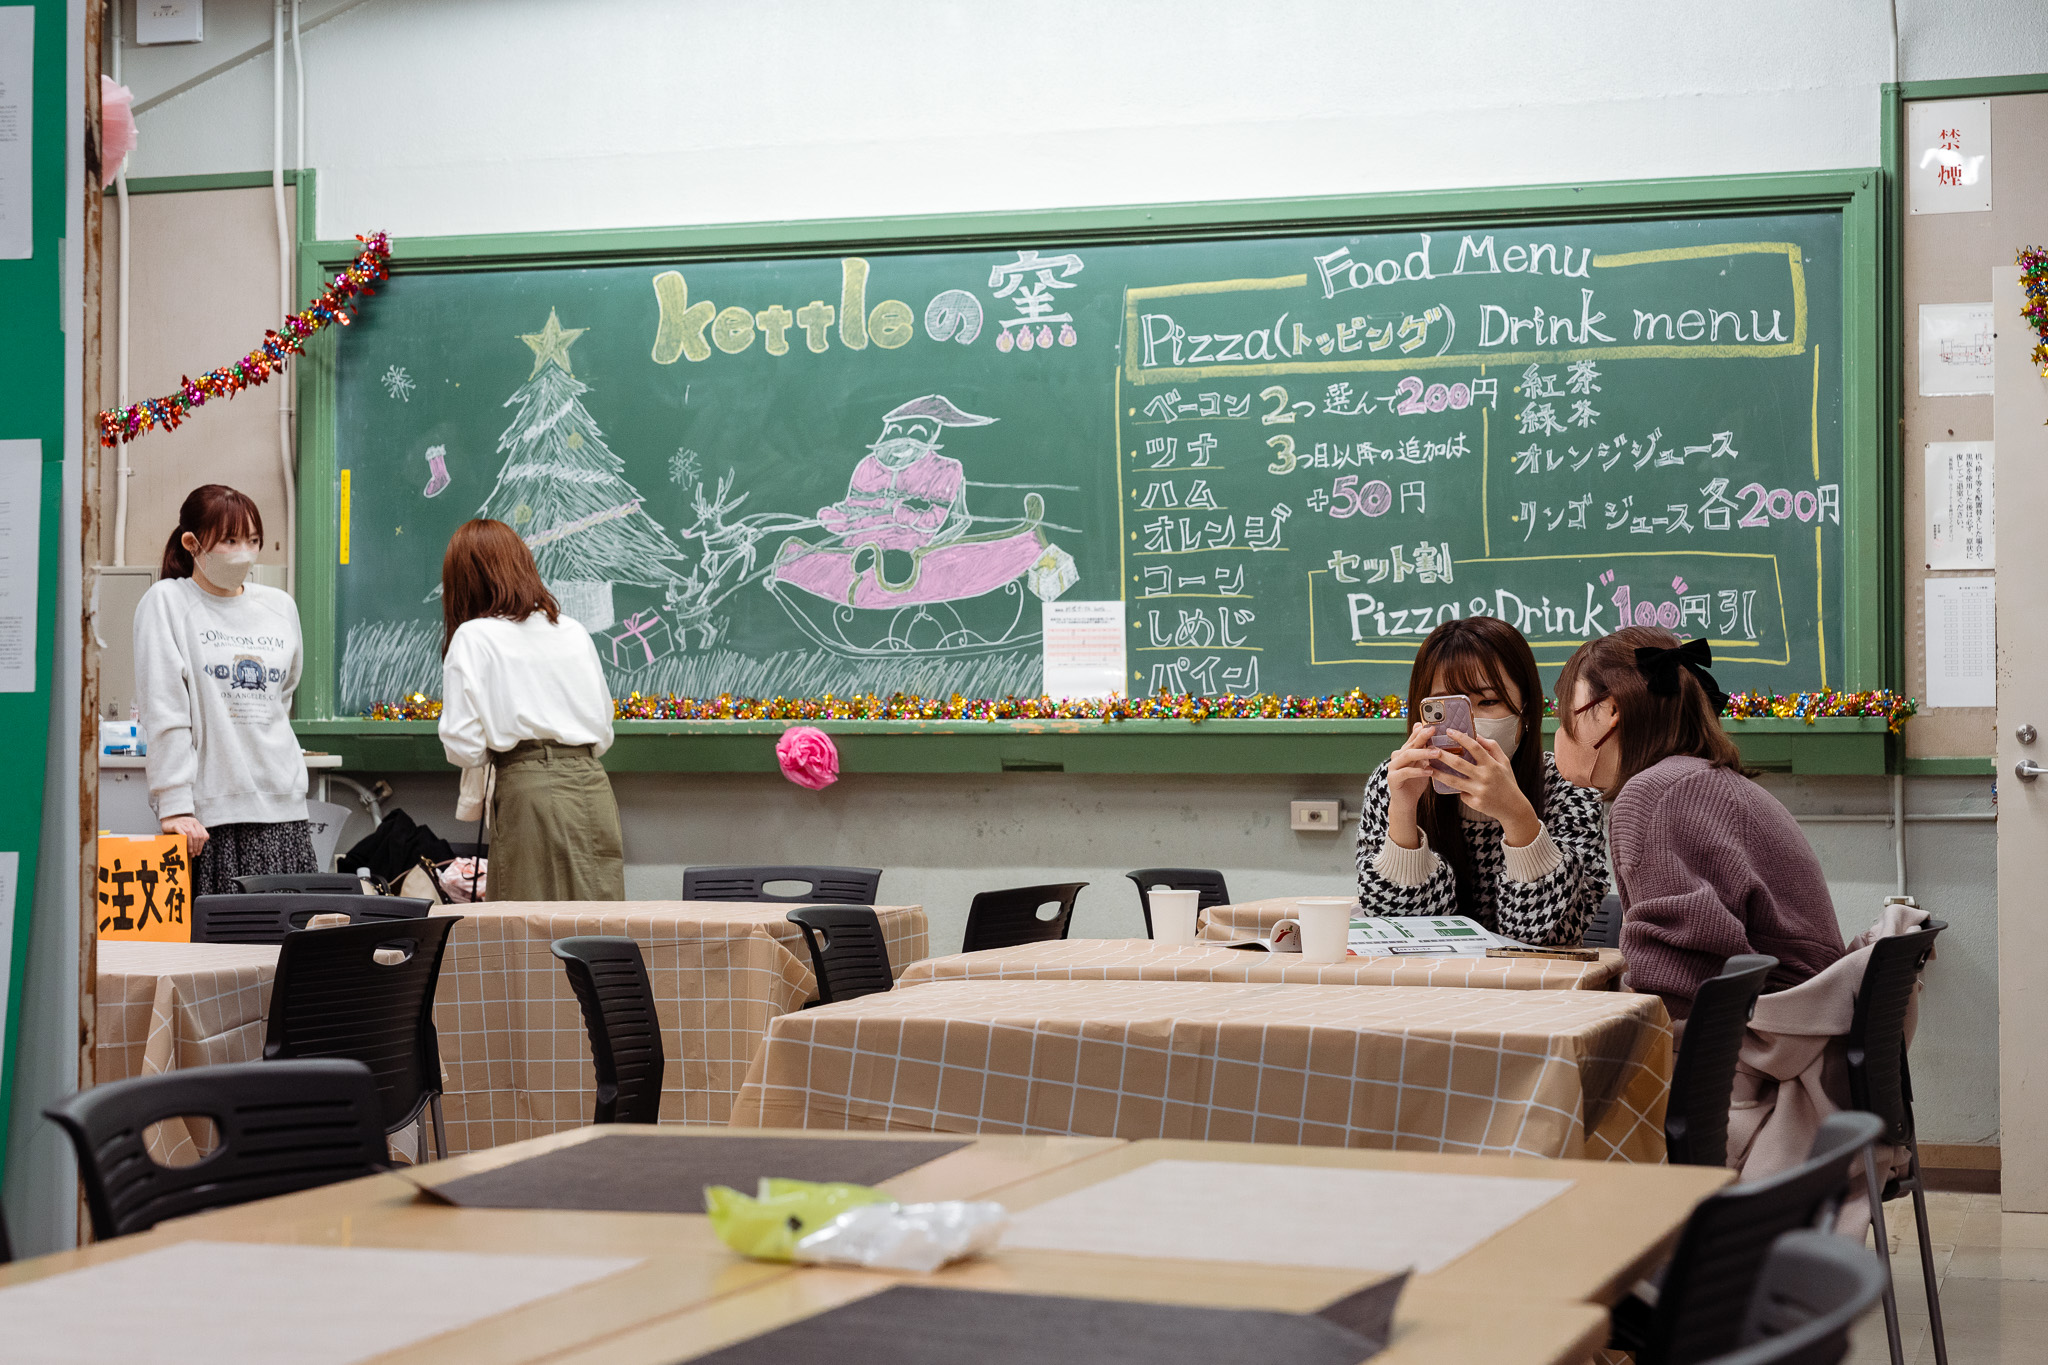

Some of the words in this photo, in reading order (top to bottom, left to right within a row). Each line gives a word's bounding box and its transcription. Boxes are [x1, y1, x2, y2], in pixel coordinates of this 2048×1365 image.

[1937, 128, 1963, 188] 禁煙
[1315, 234, 1431, 298] Food
[1453, 235, 1594, 279] Menu
[1479, 288, 1617, 347] Drink
[1633, 307, 1788, 343] menu
[1520, 359, 1602, 400] 紅茶
[1144, 388, 1251, 424] ベーコン
[1519, 399, 1600, 436] 緑茶
[1145, 433, 1218, 468] ツナ
[1515, 427, 1739, 475] オレンジジュース
[1140, 479, 1218, 509] ハム
[1143, 503, 1292, 552] オレンジ
[1144, 564, 1245, 598] コーン
[1328, 541, 1454, 584] セット割
[257, 635, 285, 650] GYM
[1149, 606, 1256, 648] しめじ
[1148, 655, 1259, 699] パイン
[97, 858, 163, 932] 注文
[159, 843, 186, 925] 受付
